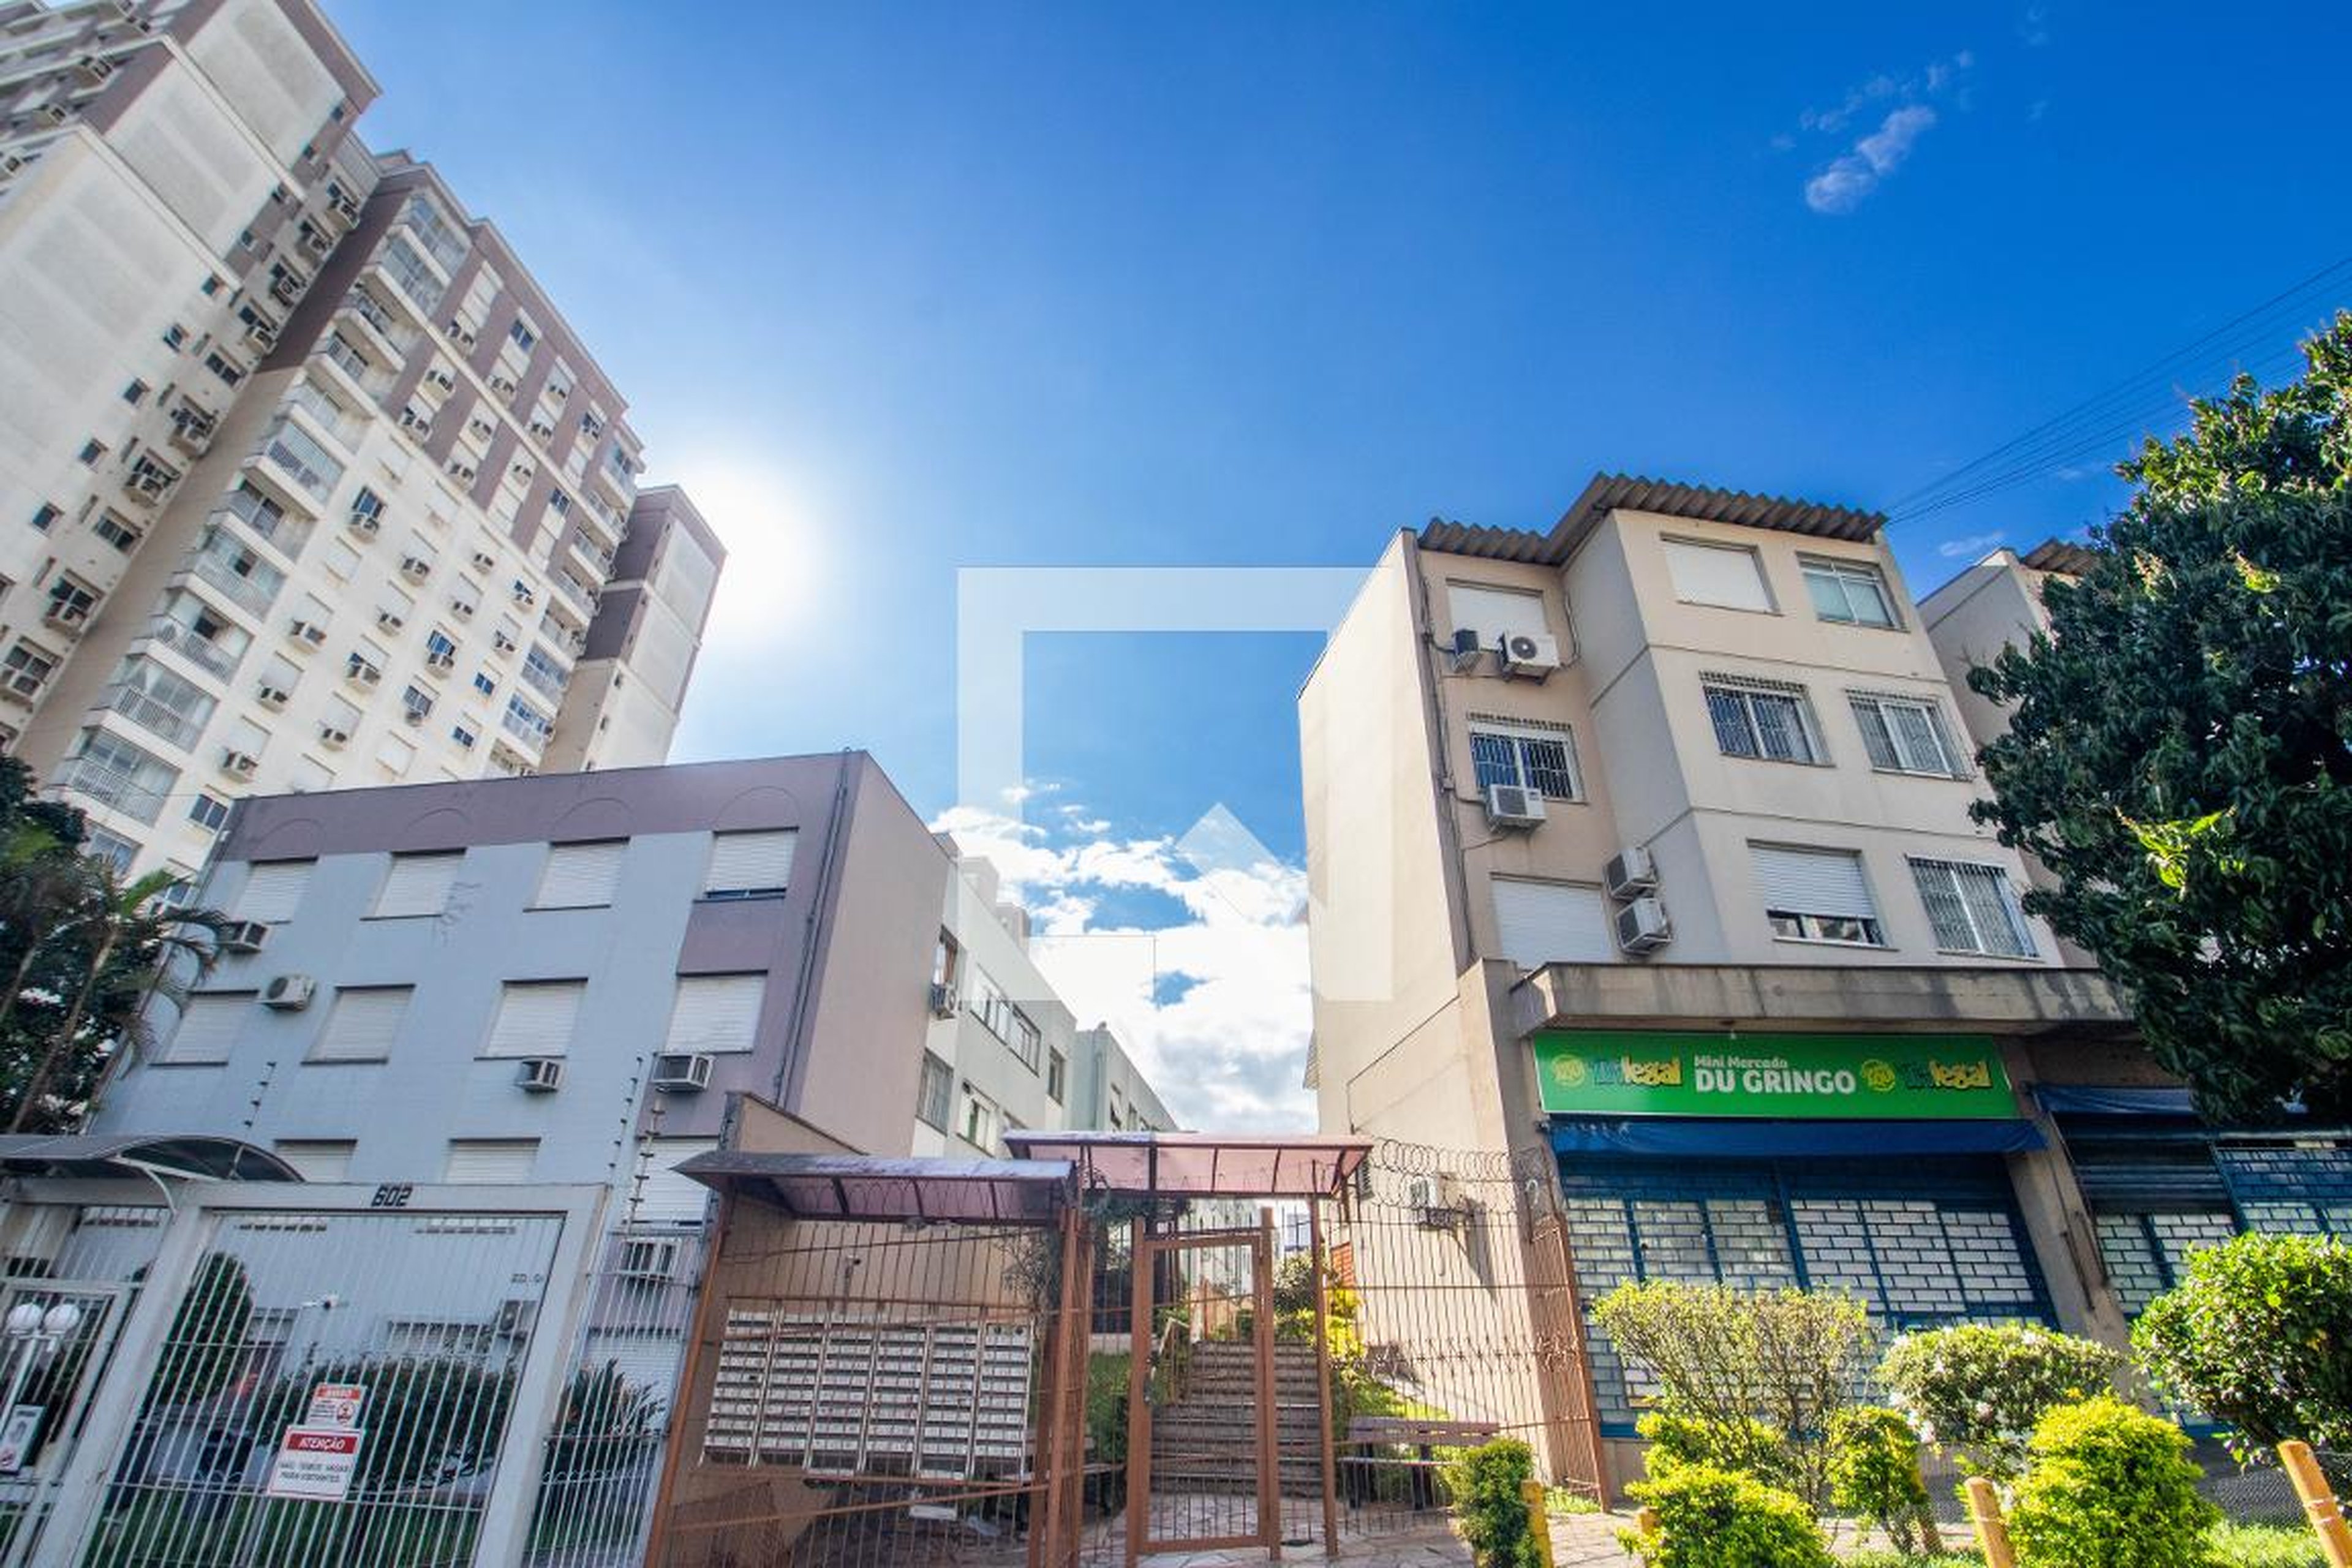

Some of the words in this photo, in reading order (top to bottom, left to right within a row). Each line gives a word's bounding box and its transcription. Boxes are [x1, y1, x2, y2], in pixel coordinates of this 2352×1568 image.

[1694, 1055, 1724, 1068] Mini
[1727, 1055, 1788, 1069] Mercado
[1695, 1069, 1736, 1093] DU
[1743, 1070, 1856, 1095] GRINGO
[371, 1183, 413, 1207] 602
[298, 1437, 346, 1450] ATENÇÃO
